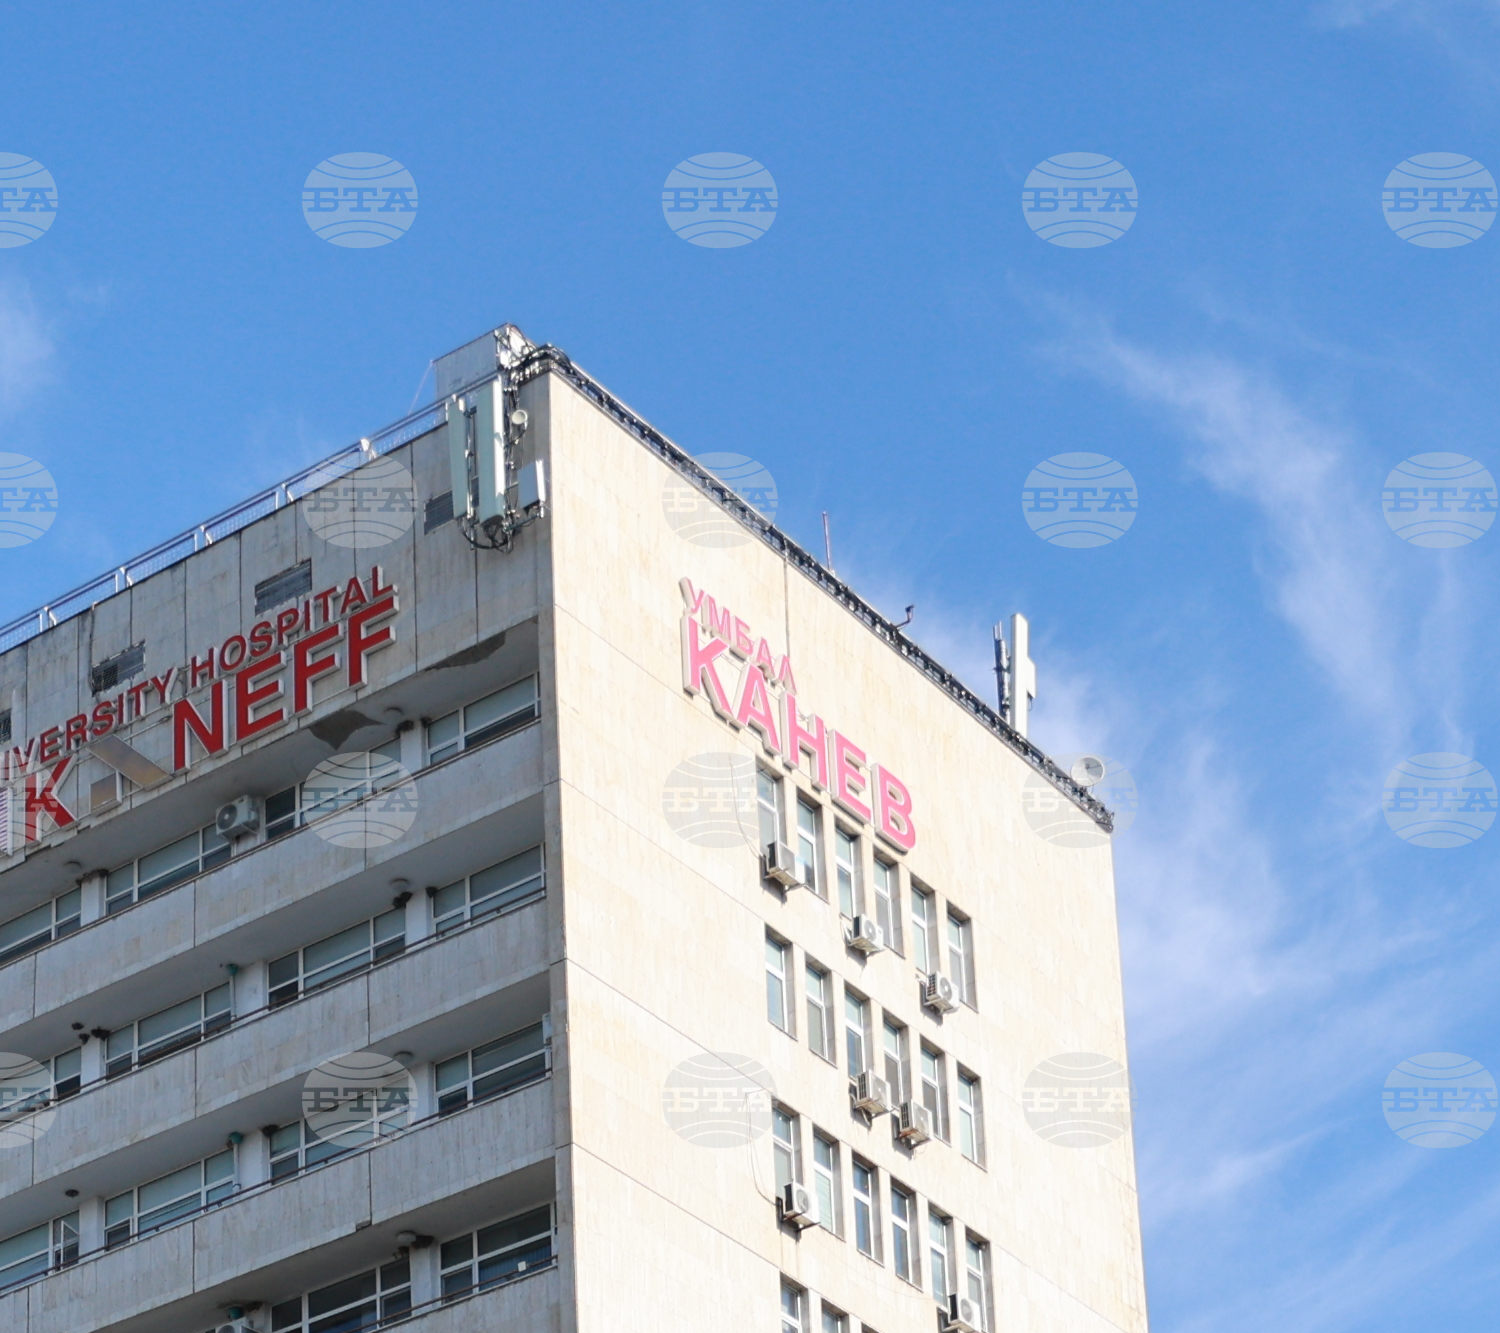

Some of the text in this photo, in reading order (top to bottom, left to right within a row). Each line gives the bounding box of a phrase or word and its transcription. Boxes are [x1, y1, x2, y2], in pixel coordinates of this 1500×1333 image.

[190, 565, 394, 688] HOSPITAL
[679, 577, 796, 694] УМБАЛ
[681, 615, 916, 854] КАНЕВ
